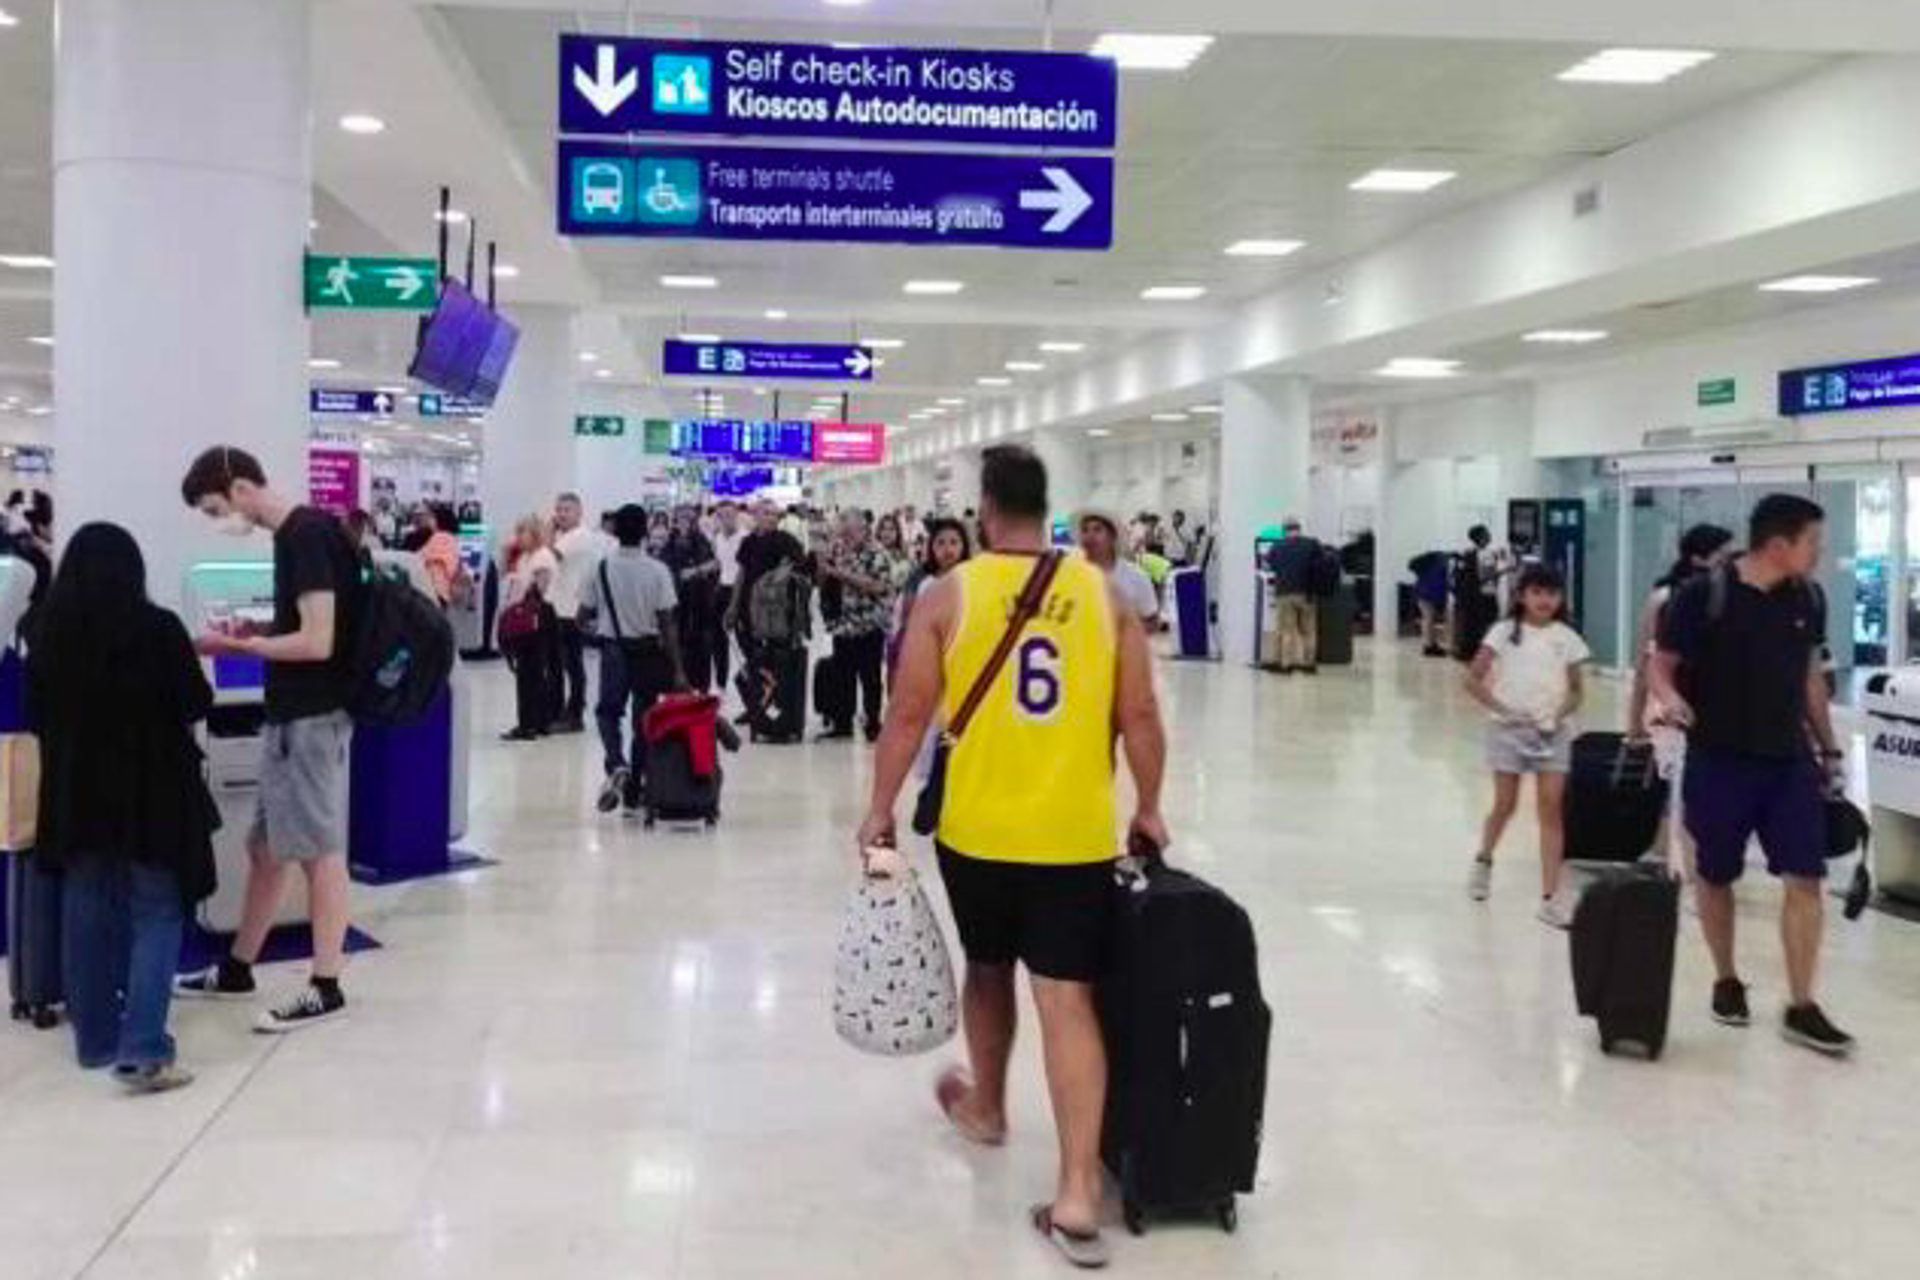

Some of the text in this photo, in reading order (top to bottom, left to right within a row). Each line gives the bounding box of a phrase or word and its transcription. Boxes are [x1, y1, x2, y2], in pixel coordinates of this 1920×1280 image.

[726, 49, 1015, 92] Self check-in Kiosks
[727, 86, 1098, 132] Kioscos Autodocumentación
[708, 161, 895, 192] Free terminals shuttle
[709, 198, 1004, 234] Transporte interterminales gratuito
[698, 347, 717, 370] E
[1804, 376, 1821, 407] E
[1016, 635, 1061, 717] 6
